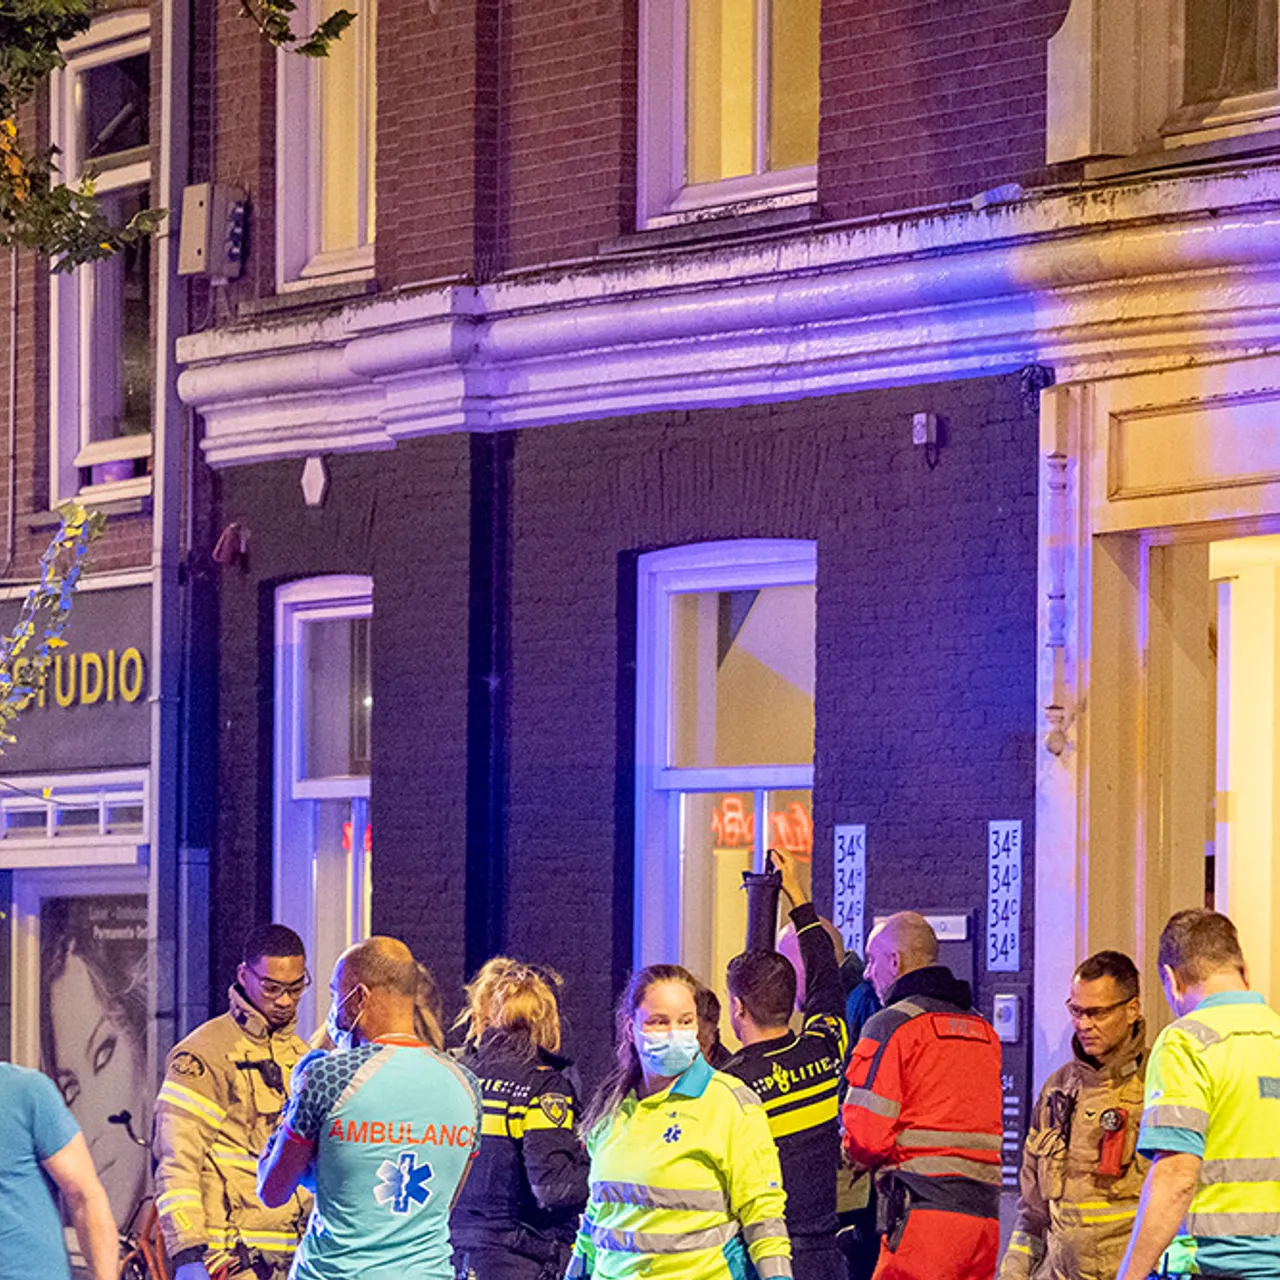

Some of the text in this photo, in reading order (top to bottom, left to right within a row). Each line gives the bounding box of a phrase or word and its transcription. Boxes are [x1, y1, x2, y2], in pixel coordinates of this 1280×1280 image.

[990, 829, 1019, 860] 34E
[990, 863, 1019, 894] 34D
[989, 898, 1018, 929] 34C
[989, 932, 1017, 963] 34B
[328, 1118, 476, 1148] AMBULANC
